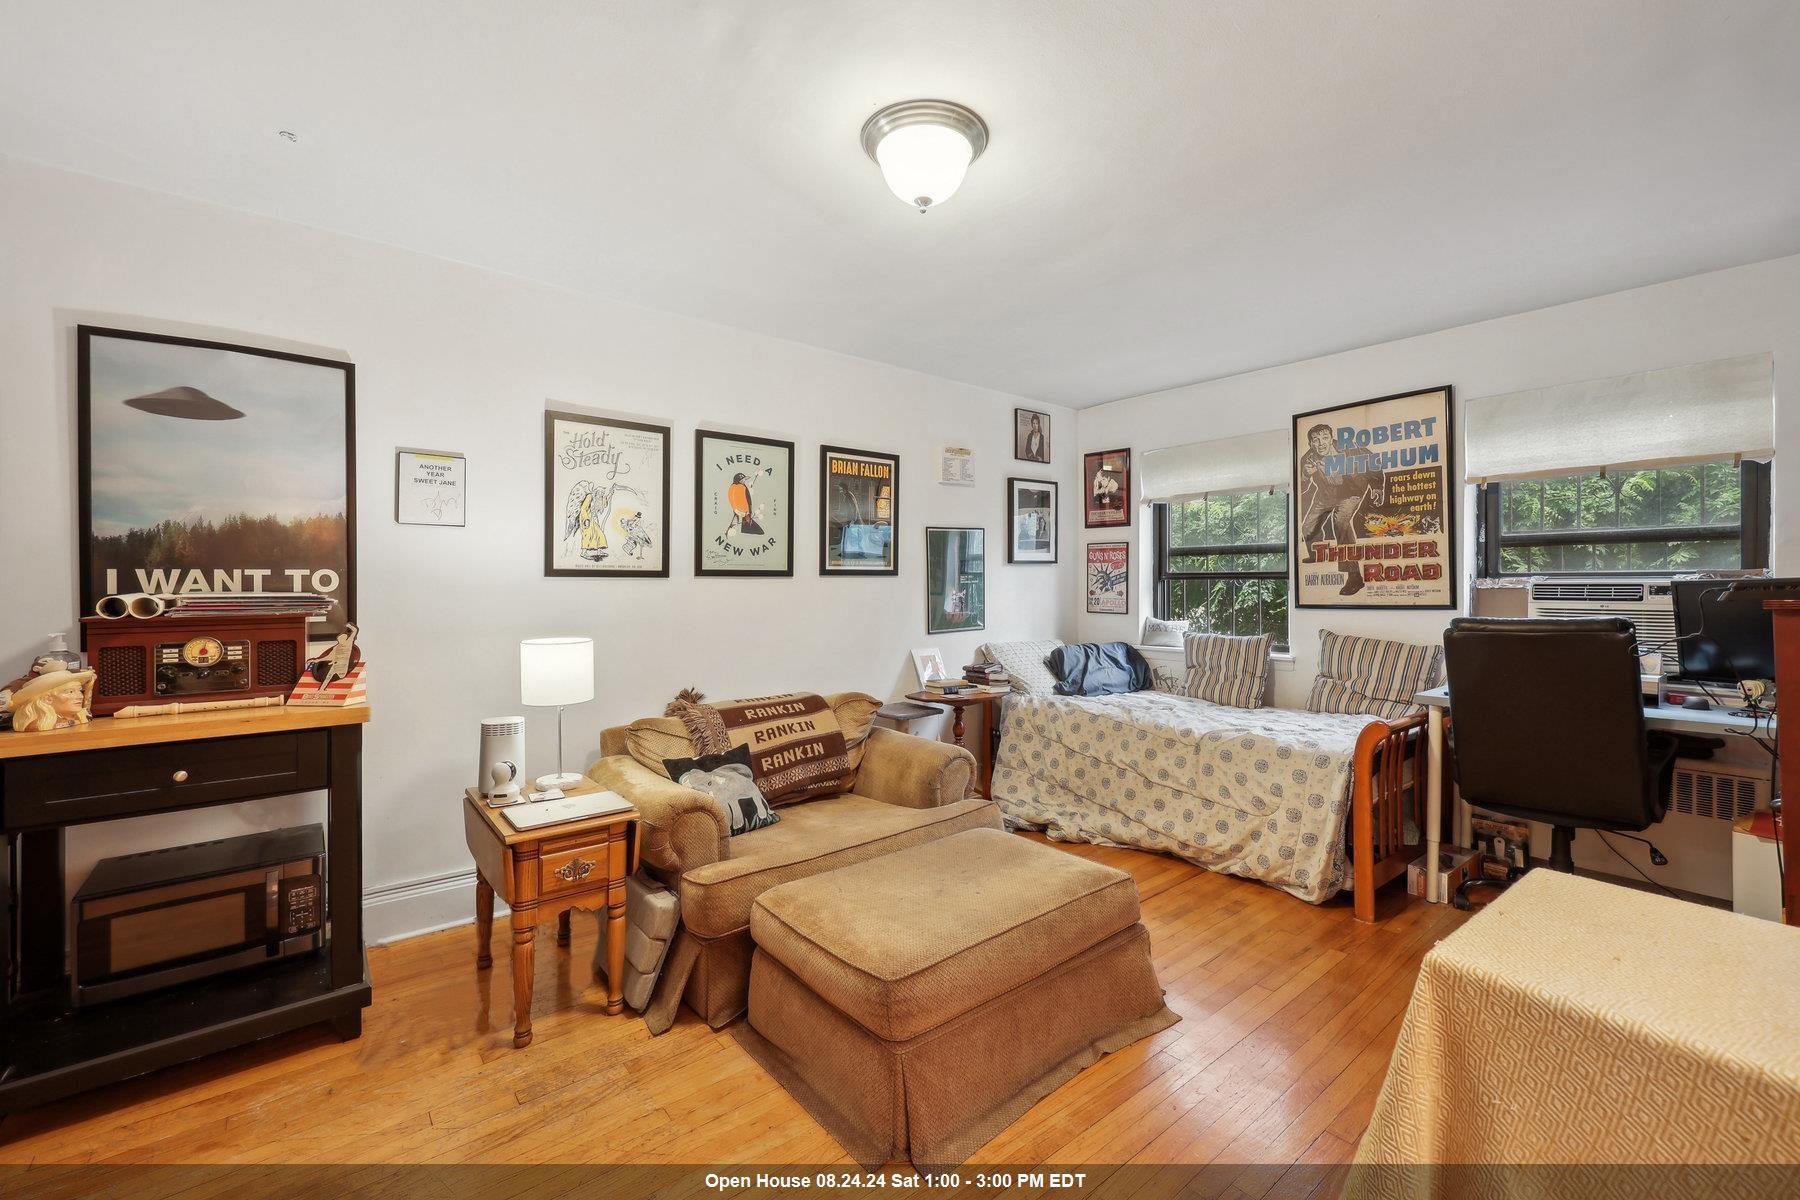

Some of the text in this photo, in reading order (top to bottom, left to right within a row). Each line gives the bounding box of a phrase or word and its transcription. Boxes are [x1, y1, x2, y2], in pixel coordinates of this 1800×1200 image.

[569, 430, 610, 449] Hold
[1337, 417, 1437, 450] ROBERT
[558, 444, 631, 481] Steady
[716, 454, 773, 476] I NEED A
[831, 459, 889, 479] BRIAN FALLON
[1324, 443, 1439, 477] MITCHUM
[413, 477, 438, 485] SWEET
[1390, 471, 1436, 483] roars down
[1392, 481, 1437, 493] the hottest
[1389, 494, 1424, 505] highway
[1410, 501, 1437, 512] earth!
[715, 535, 744, 557] NEW
[749, 537, 776, 557] WAR
[1312, 540, 1440, 562] THUNDER
[106, 568, 340, 594] I WANT TO
[1363, 562, 1442, 582] ROAD
[744, 702, 806, 720] RANKIN
[754, 720, 816, 744] RANKIN
[760, 742, 825, 771] RANKIN
